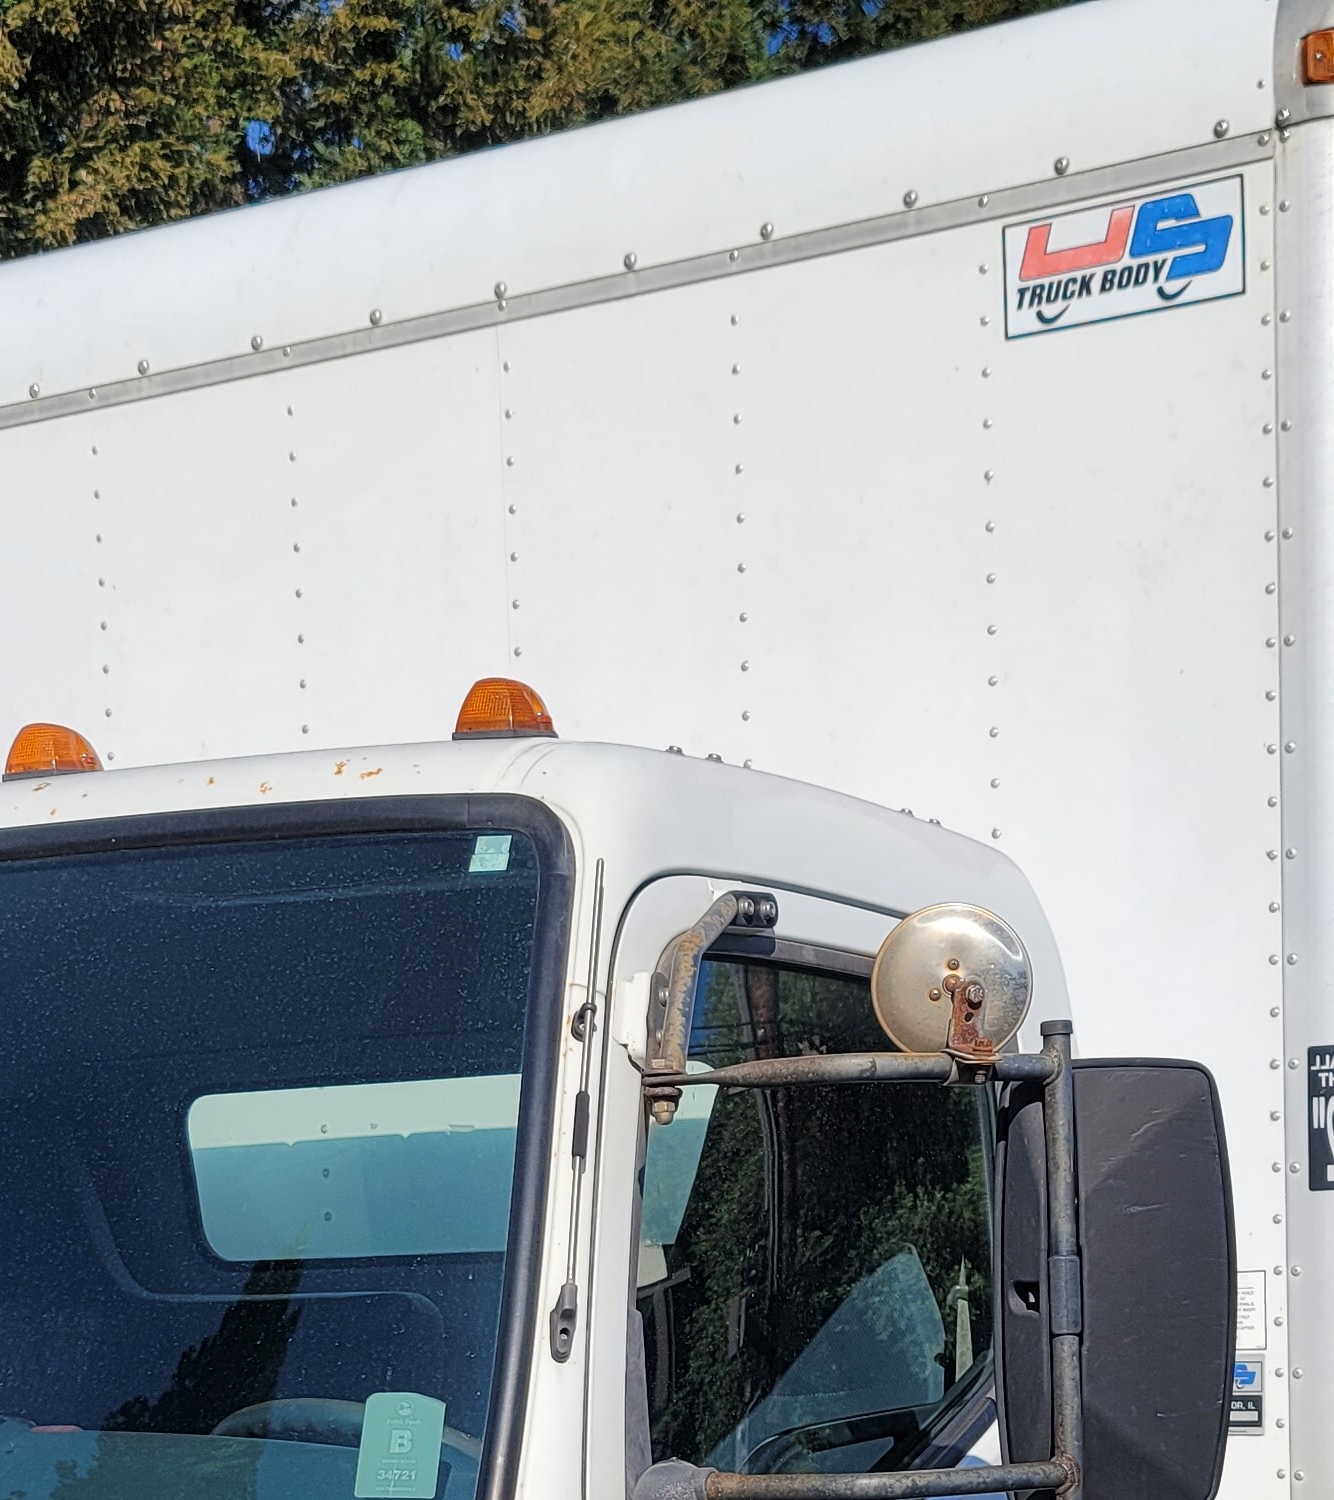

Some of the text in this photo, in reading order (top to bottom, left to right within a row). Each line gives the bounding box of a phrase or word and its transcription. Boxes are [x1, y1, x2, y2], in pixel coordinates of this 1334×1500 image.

[1019, 193, 1233, 281] US
[1017, 258, 1168, 311] TRUCK BODY
[389, 1429, 413, 1454] B
